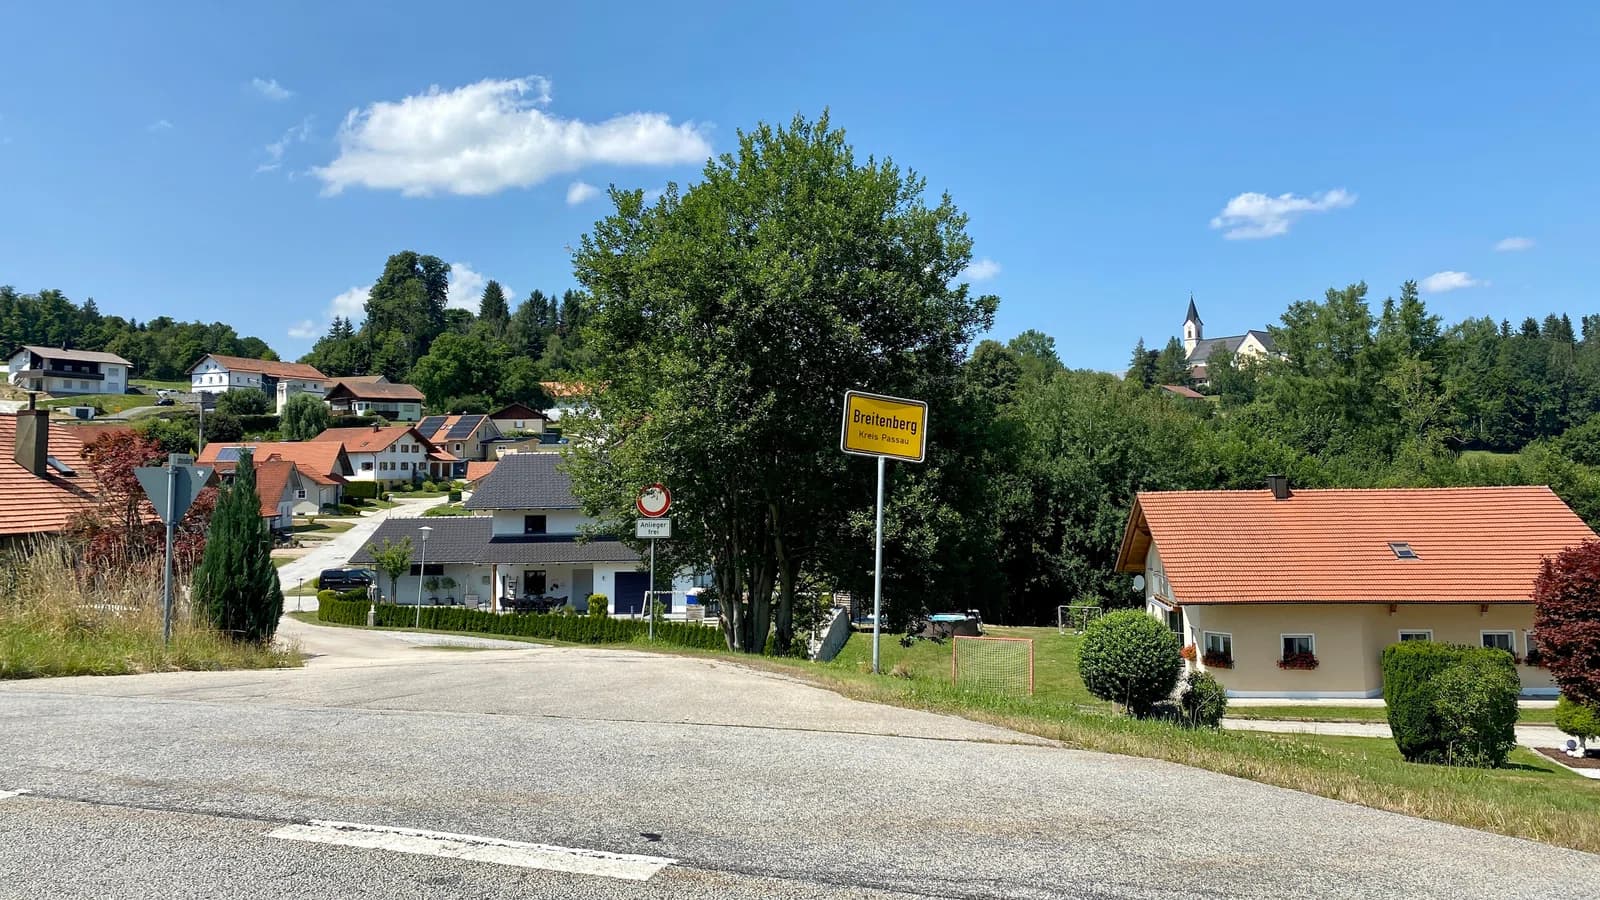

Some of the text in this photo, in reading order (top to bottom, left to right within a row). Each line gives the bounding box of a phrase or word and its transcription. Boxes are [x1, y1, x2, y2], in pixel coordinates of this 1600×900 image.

[854, 409, 917, 435] Breitenberg
[858, 430, 909, 445] Kreis Passau
